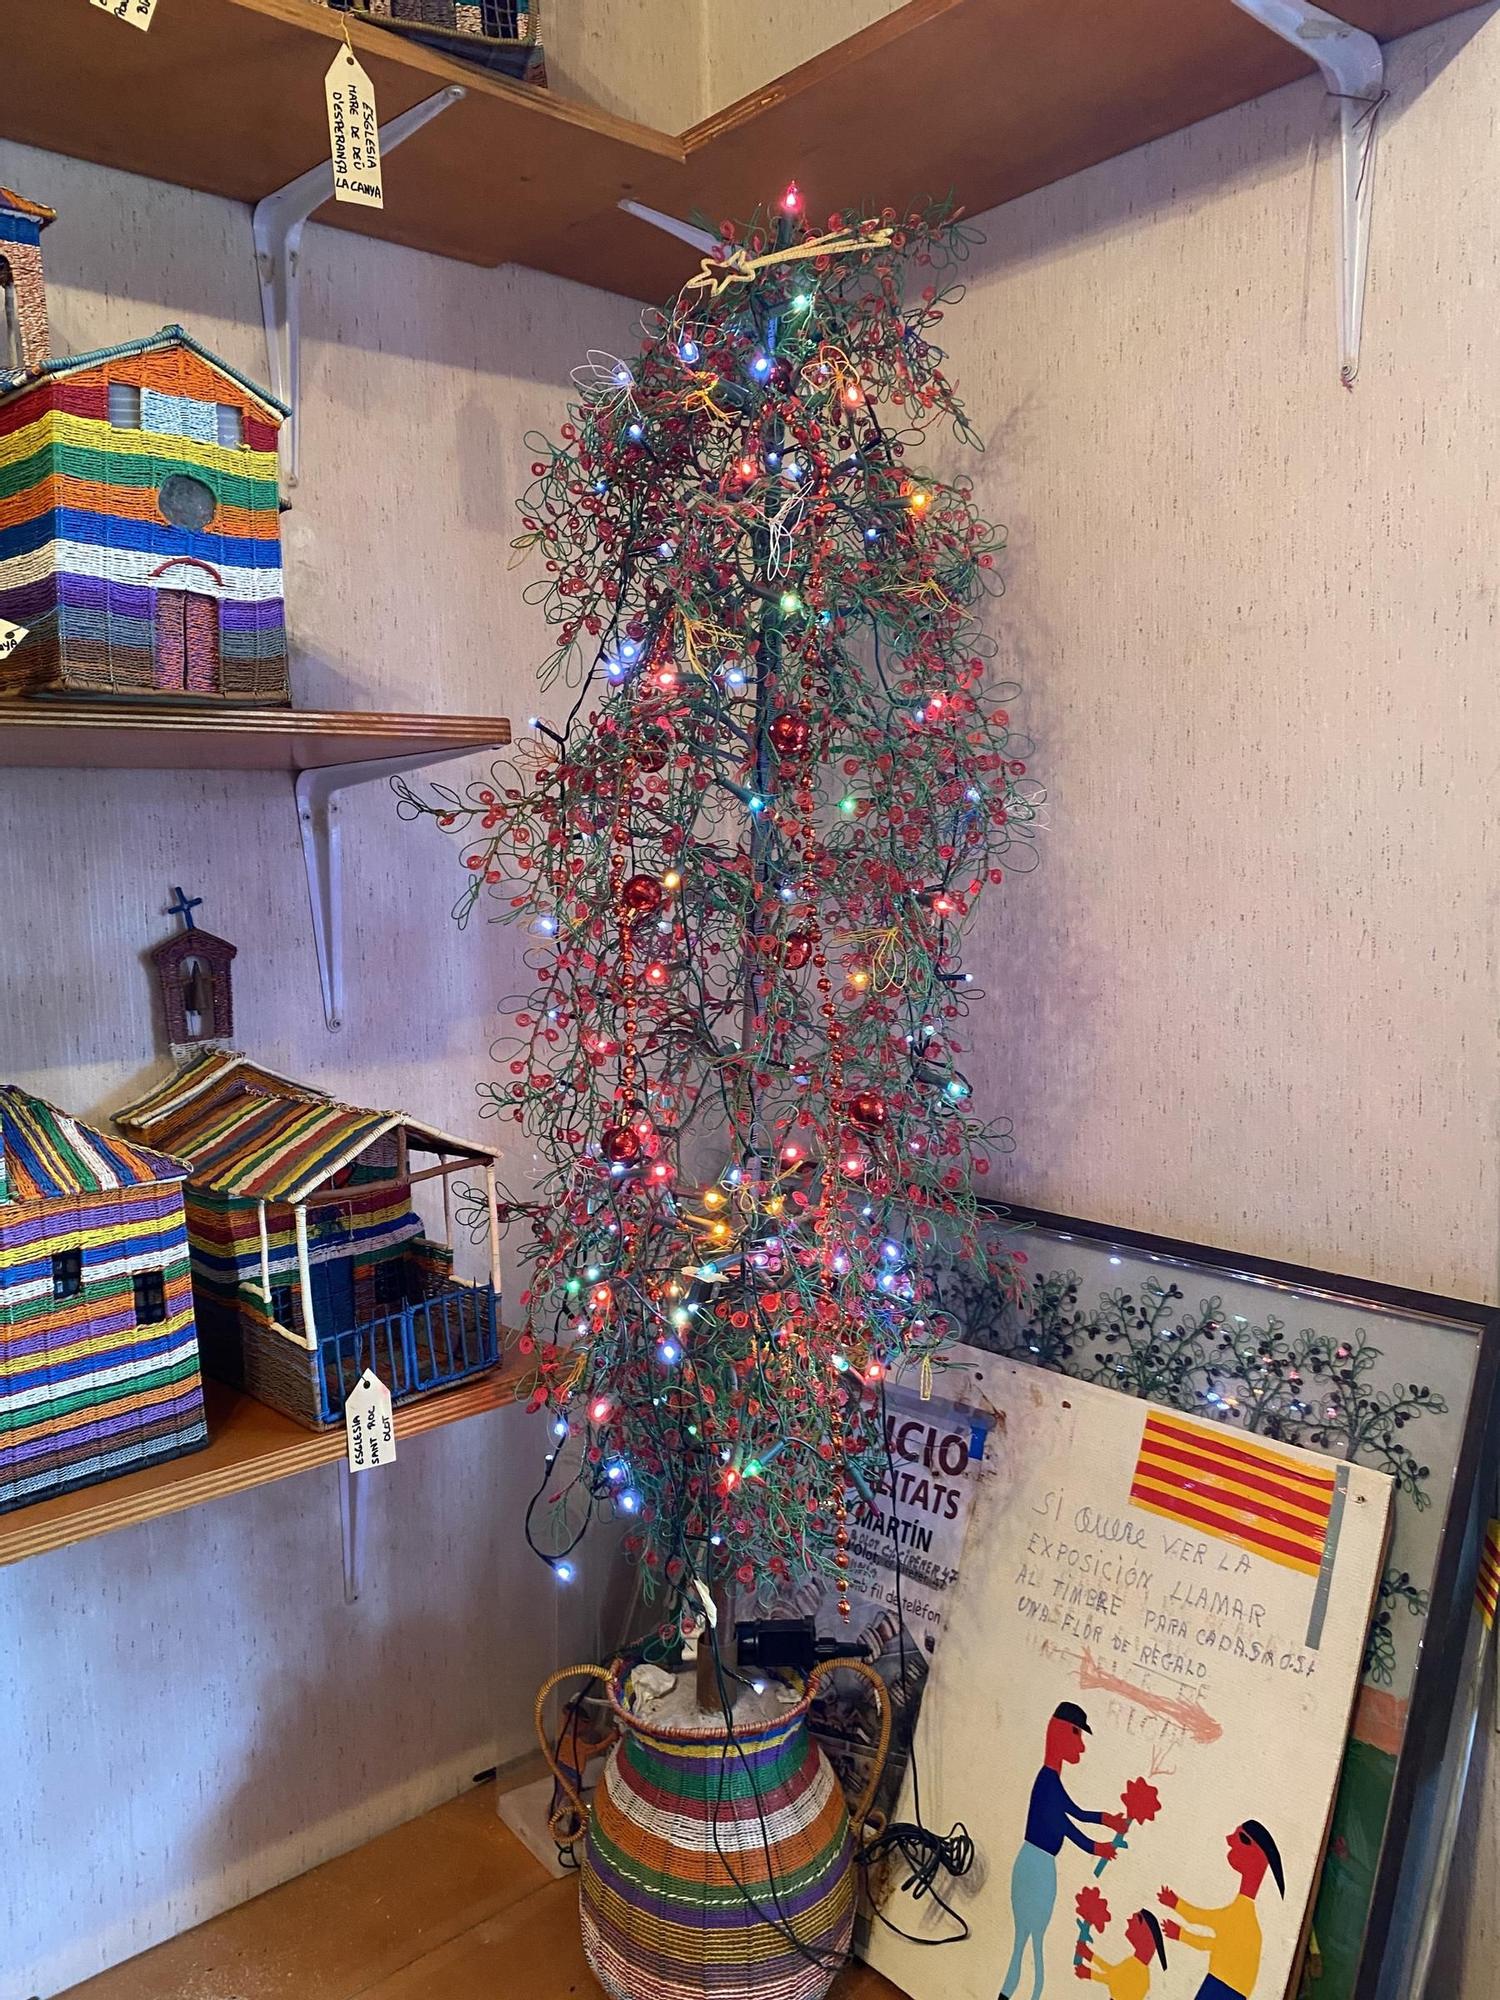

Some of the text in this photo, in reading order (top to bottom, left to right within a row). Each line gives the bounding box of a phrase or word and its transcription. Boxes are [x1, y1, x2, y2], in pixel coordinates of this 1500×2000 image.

[347, 84, 359, 116] MARE
[350, 126, 360, 140] DE
[335, 177, 382, 198] LA CANYA
[366, 1405, 380, 1465] SANT ROC
[381, 1415, 391, 1442] OLOT
[1161, 1534, 1208, 1565] VER
[1218, 1552, 1252, 1574] LA
[902, 1596, 942, 1625] telèfon
[1014, 1563, 1036, 1587] AL
[1143, 1609, 1188, 1639] PARA
[1169, 1580, 1267, 1629] LLAMAR
[1061, 1613, 1102, 1644] FLOR
[1111, 1635, 1131, 1655] DE
[1139, 1643, 1208, 1679] REGALO
